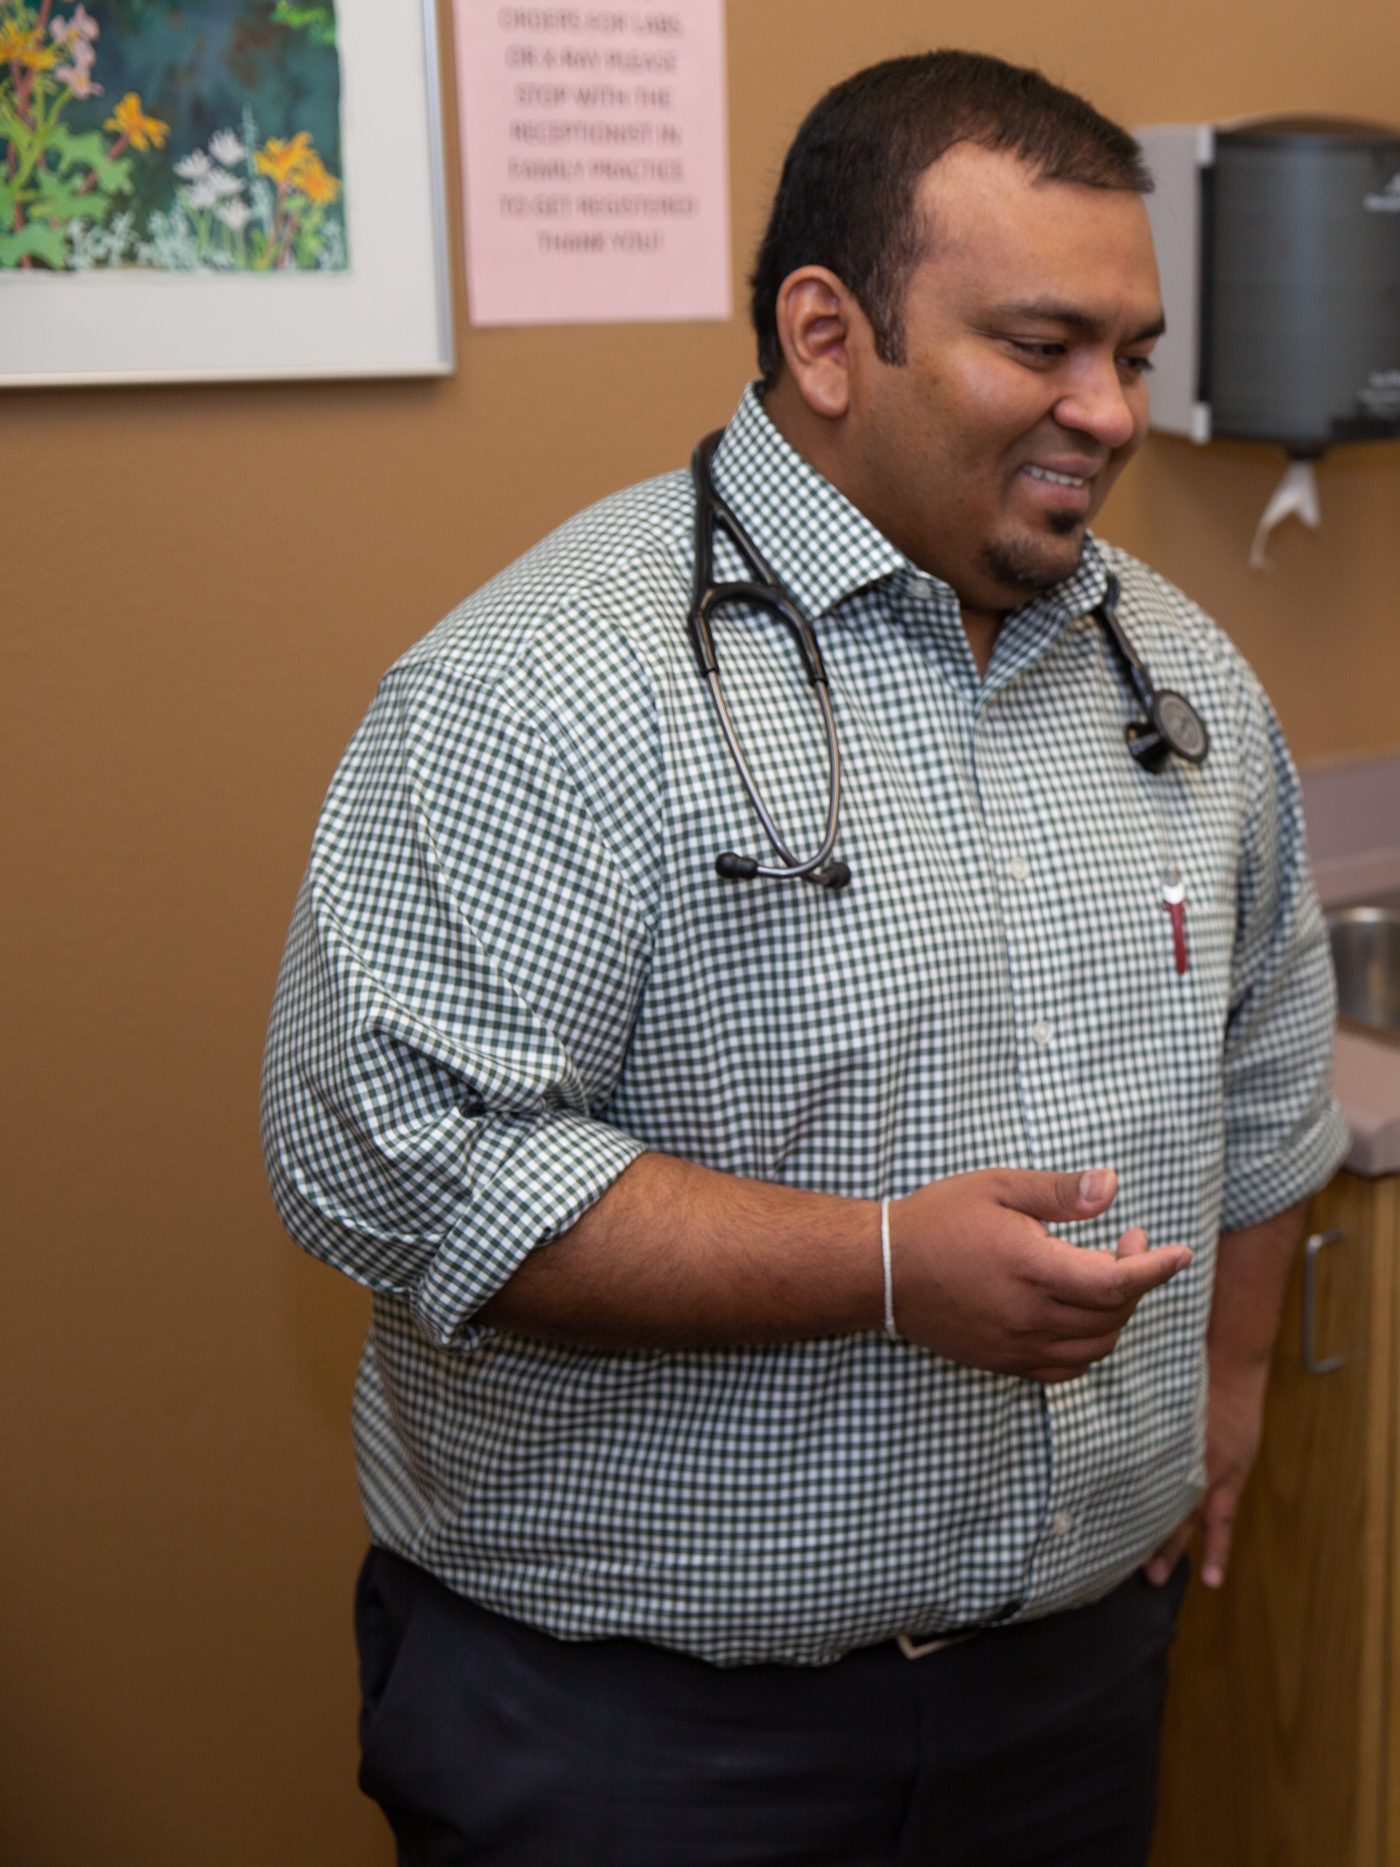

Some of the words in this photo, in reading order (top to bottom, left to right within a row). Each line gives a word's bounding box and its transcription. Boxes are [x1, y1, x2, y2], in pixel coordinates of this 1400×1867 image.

[513, 83, 570, 109] STOP
[572, 84, 628, 110] WITH
[632, 85, 675, 111] THE
[509, 119, 654, 147] RECEPTIONIST
[657, 121, 681, 147] IN
[507, 157, 586, 183] FAMILY
[587, 158, 686, 184] PRACTICE
[497, 194, 529, 219] TO
[531, 194, 572, 219] GET
[535, 230, 607, 255] THANK
[609, 230, 663, 255] YOU!
